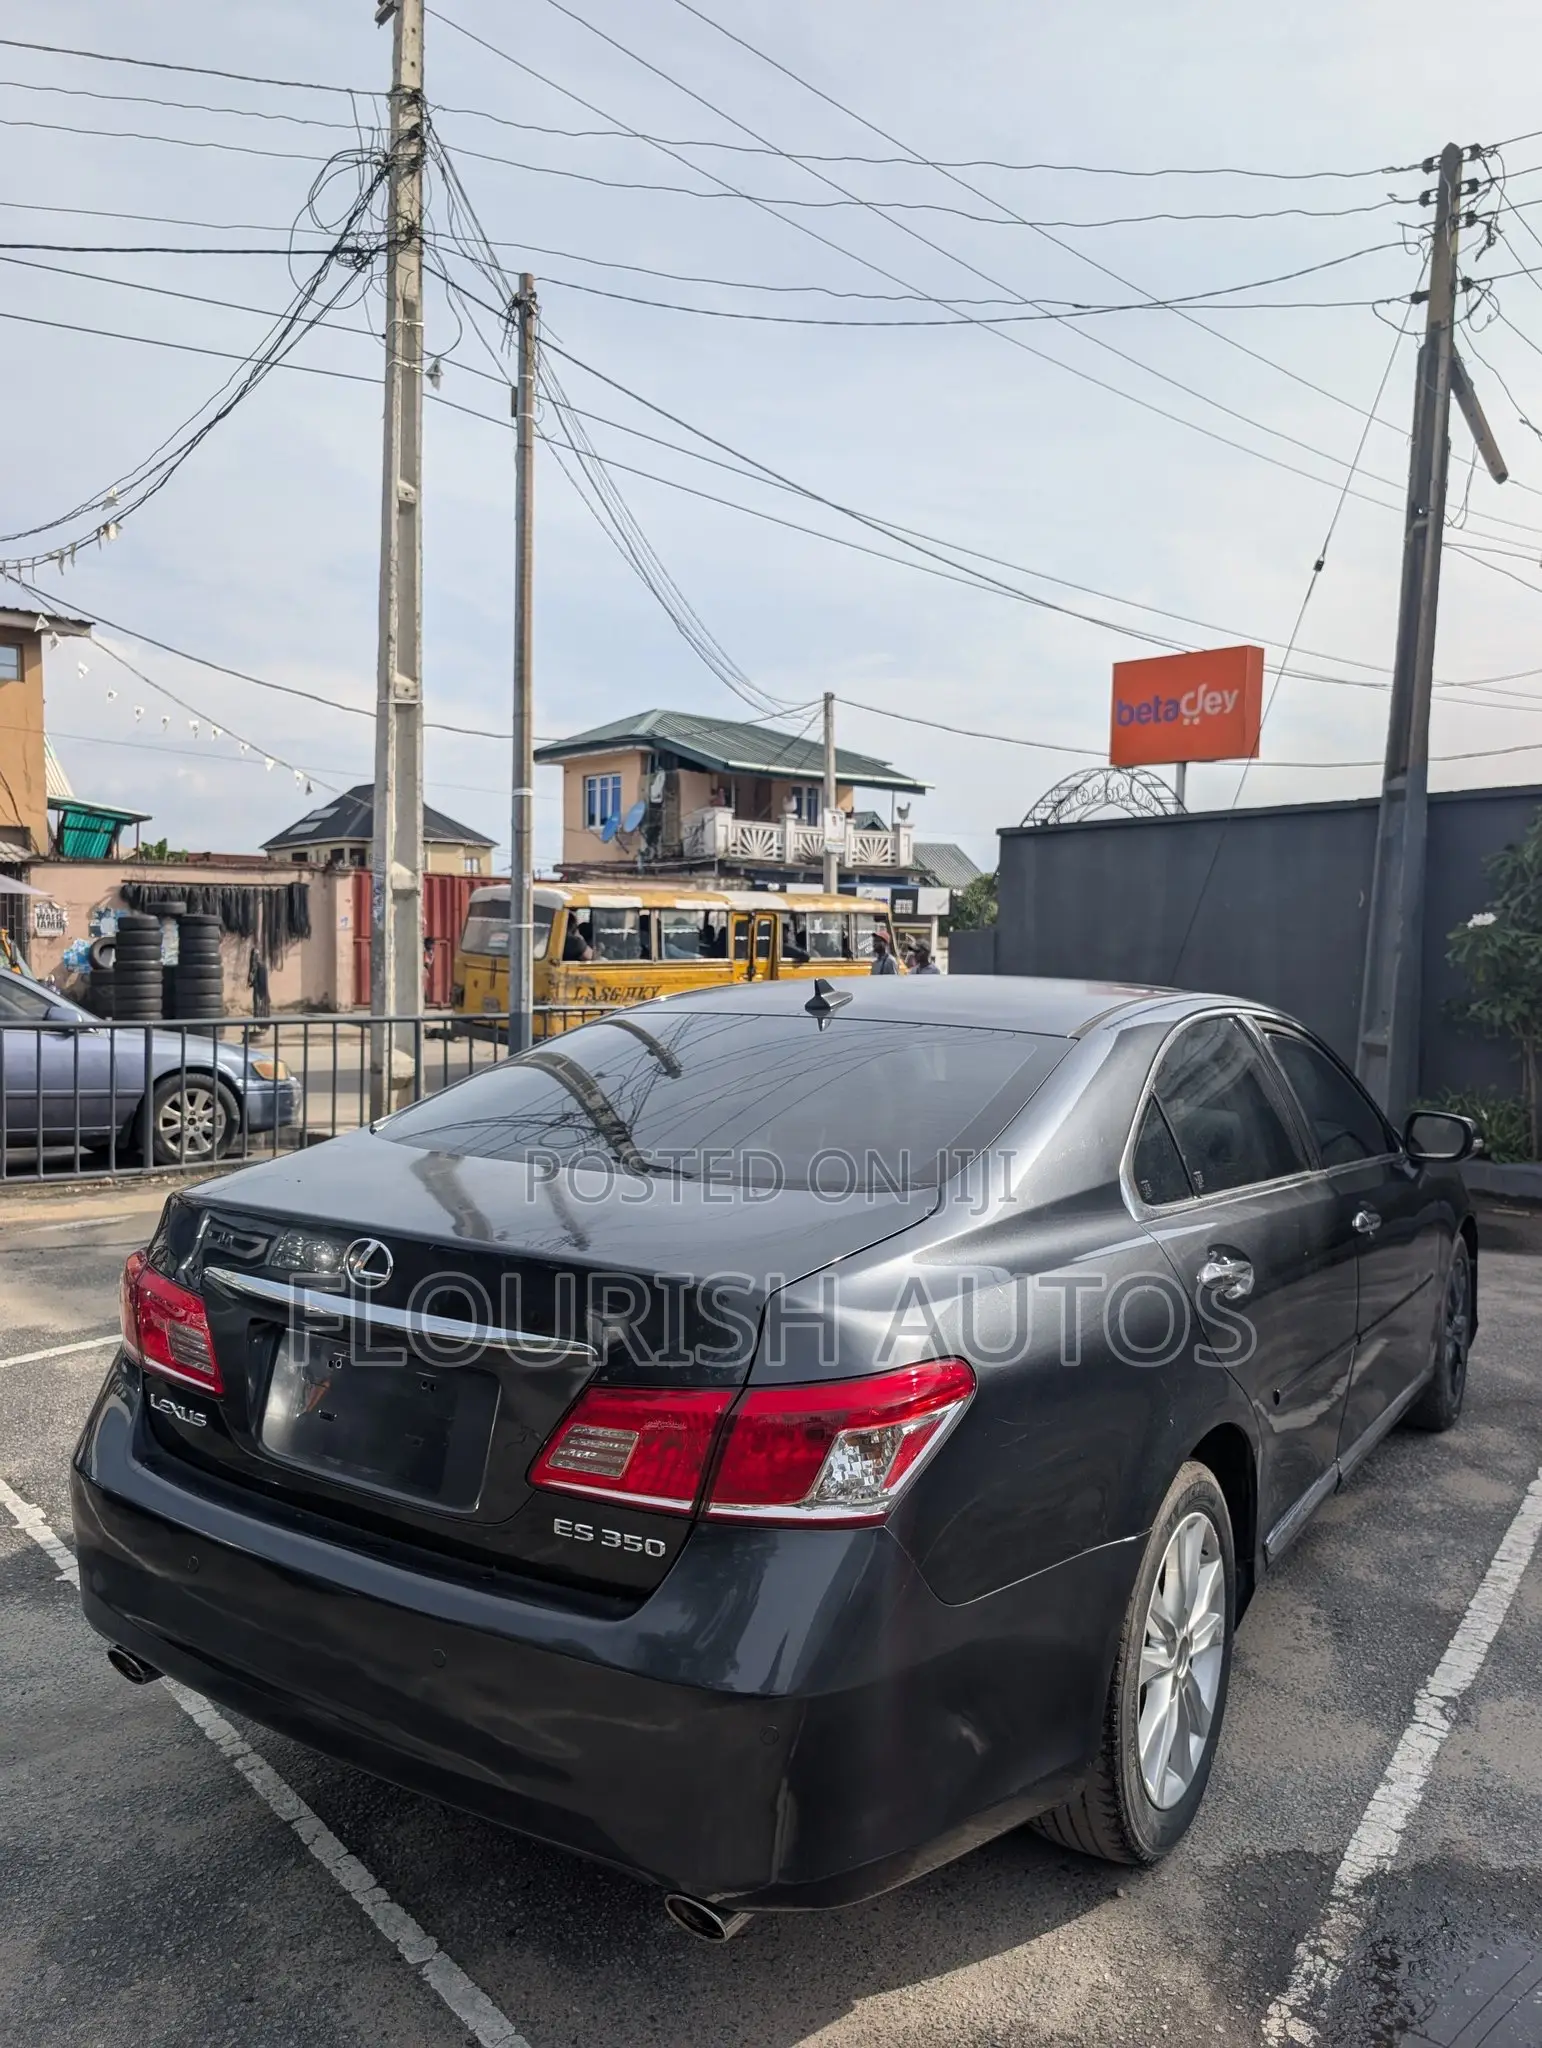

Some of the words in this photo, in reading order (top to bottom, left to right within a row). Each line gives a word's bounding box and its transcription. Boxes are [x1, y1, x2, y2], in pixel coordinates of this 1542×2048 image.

[1116, 683, 1239, 727] betadey
[150, 1393, 207, 1427] LEXUS
[553, 1518, 594, 1542] ES
[601, 1528, 666, 1557] 350
